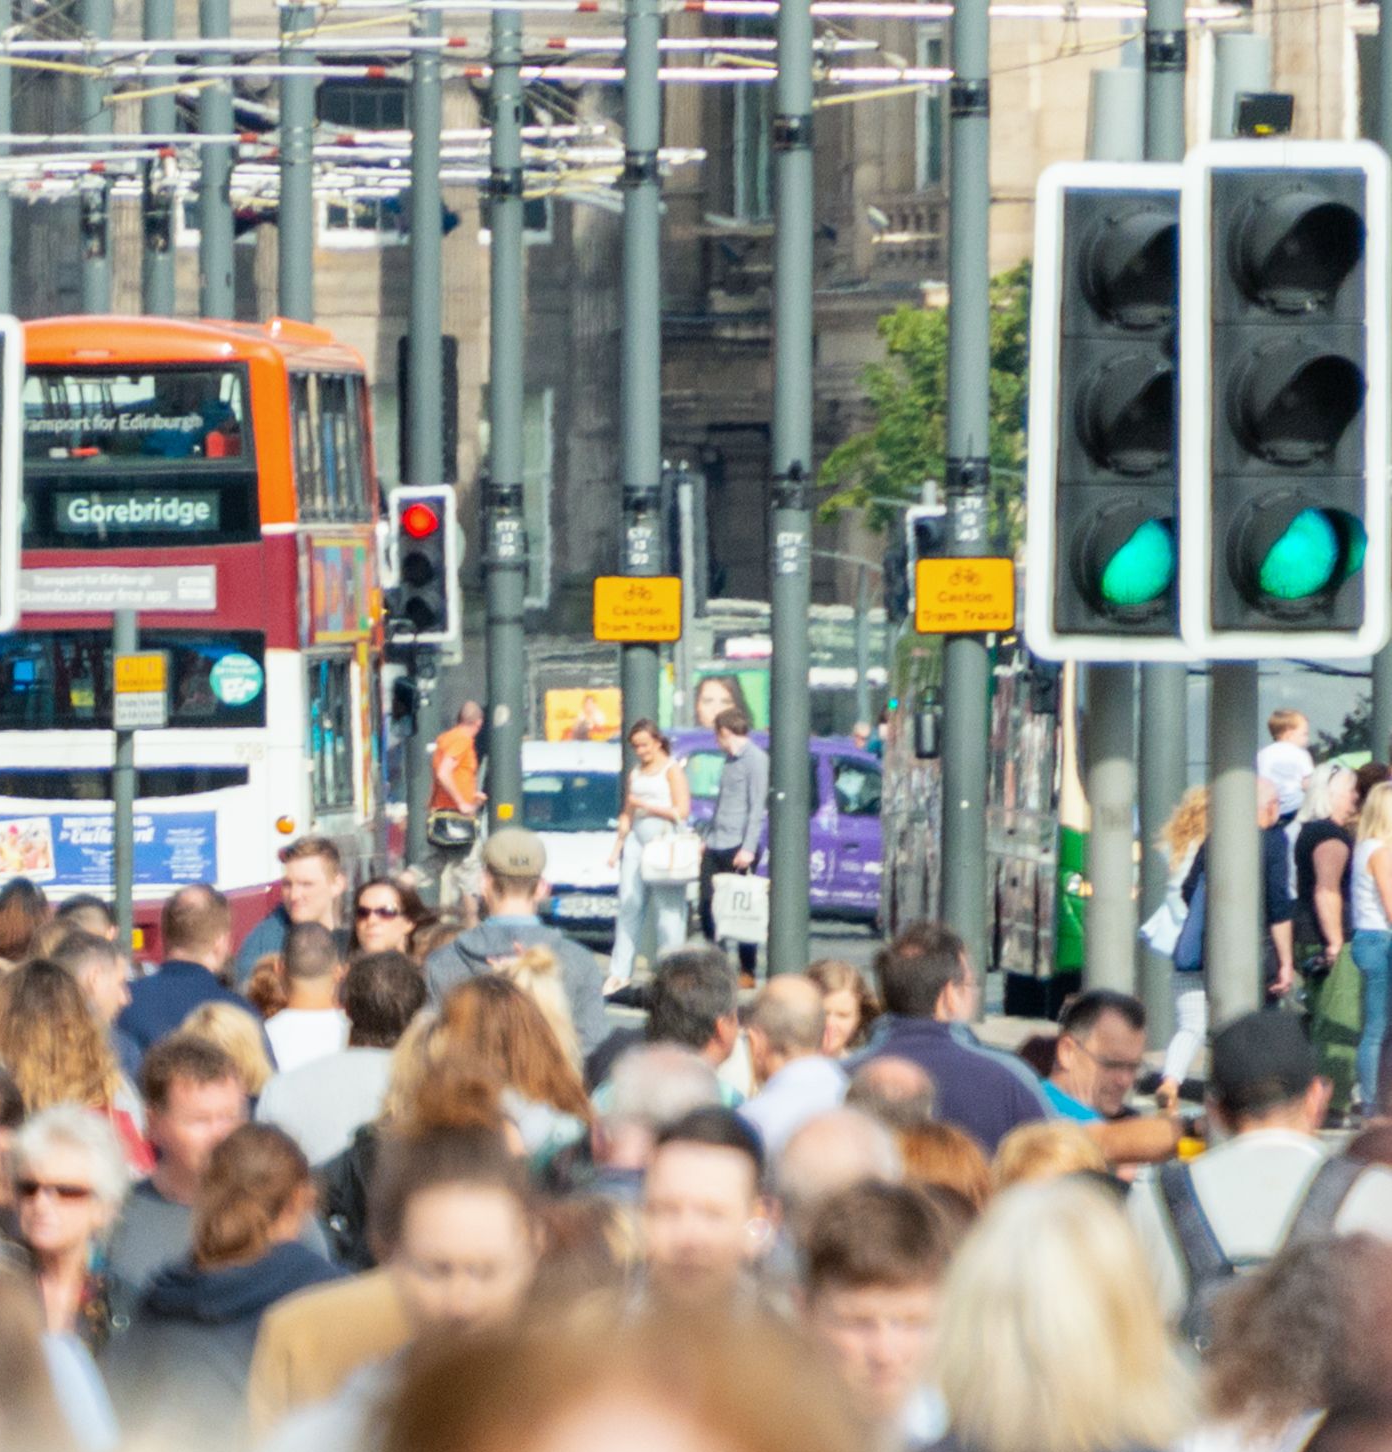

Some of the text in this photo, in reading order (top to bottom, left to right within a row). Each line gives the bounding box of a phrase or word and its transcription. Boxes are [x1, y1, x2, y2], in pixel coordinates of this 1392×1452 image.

[23, 413, 204, 433] ransport for Edinburgh
[68, 497, 211, 525] Gorebridge
[937, 591, 994, 603] Caution
[613, 606, 662, 616] Caution
[922, 609, 1008, 621] Tram Tracks
